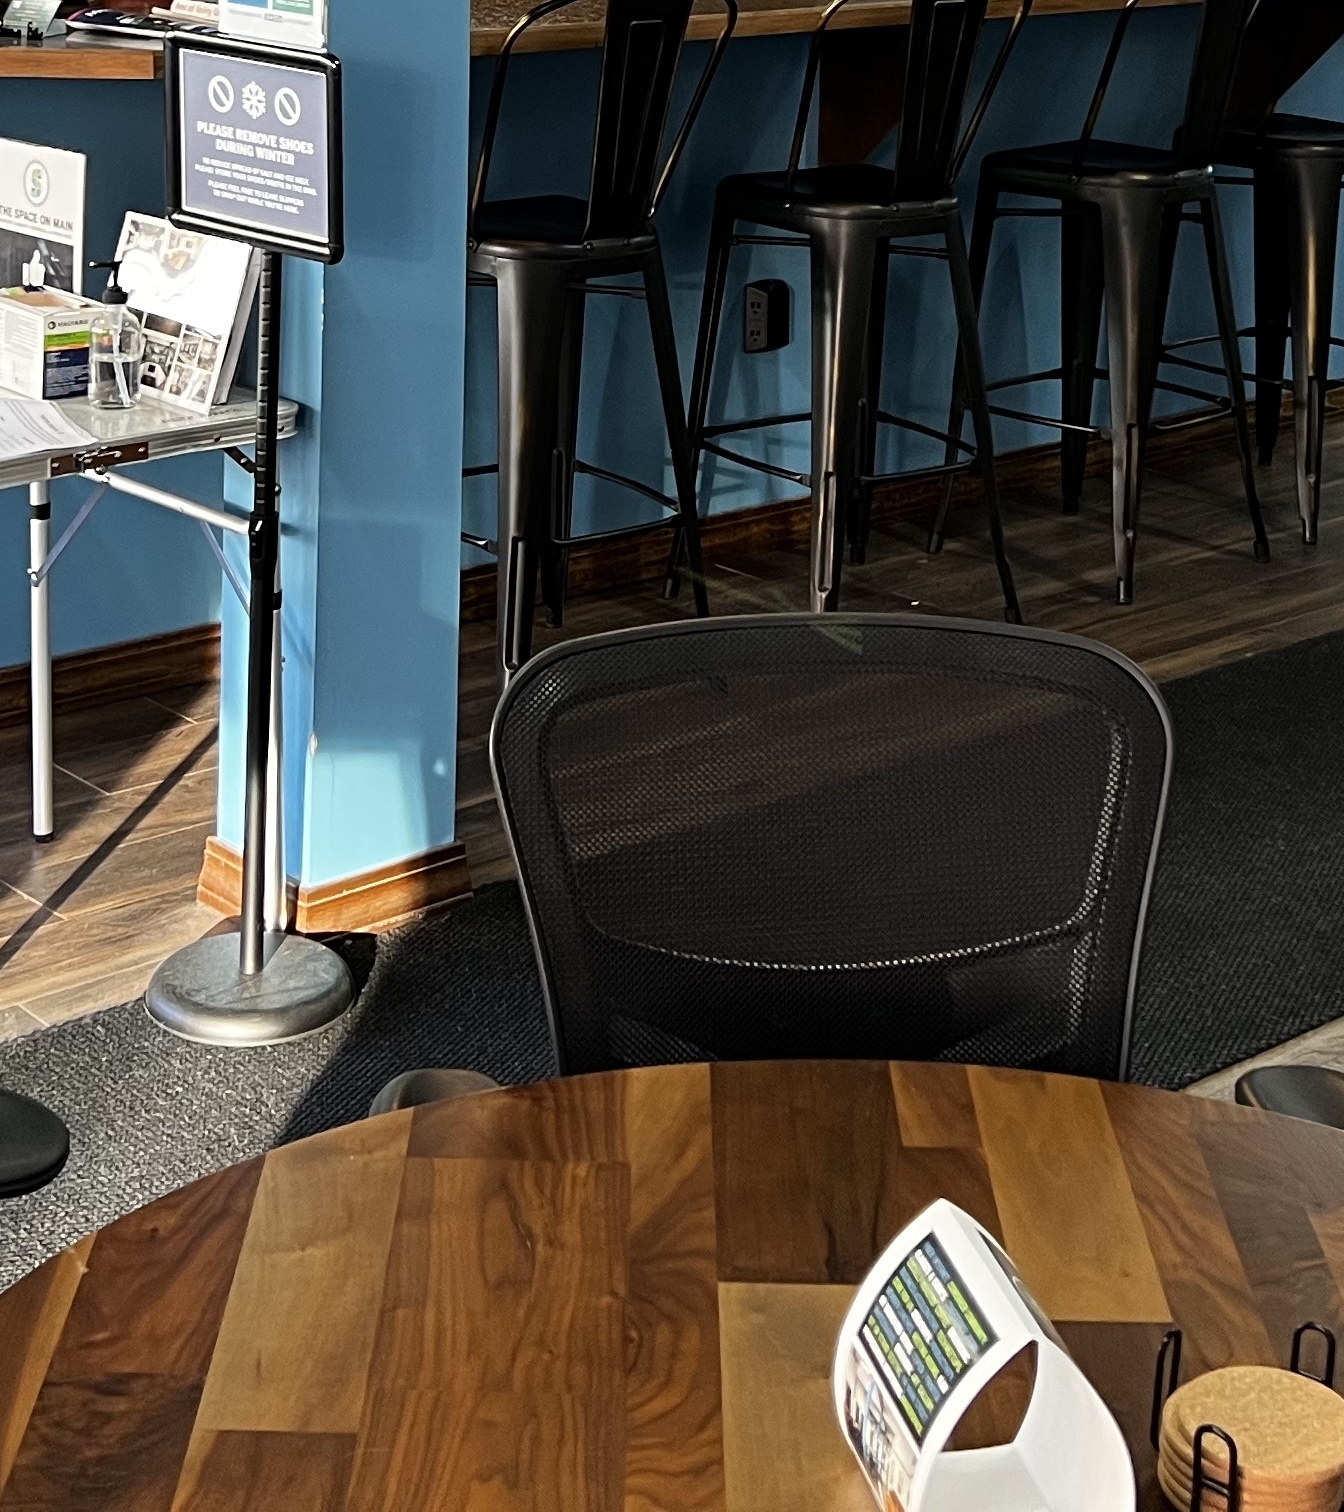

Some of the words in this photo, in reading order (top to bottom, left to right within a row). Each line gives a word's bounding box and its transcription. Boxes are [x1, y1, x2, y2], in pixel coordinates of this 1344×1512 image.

[197, 120, 235, 138] PLEASE
[235, 128, 278, 148] REMOVE
[279, 137, 314, 155] SHOES
[215, 138, 255, 157] DURING
[255, 146, 295, 166] WINTER
[14, 208, 38, 223] SPACE
[39, 214, 51, 226] ON
[53, 218, 74, 231] MAIN
